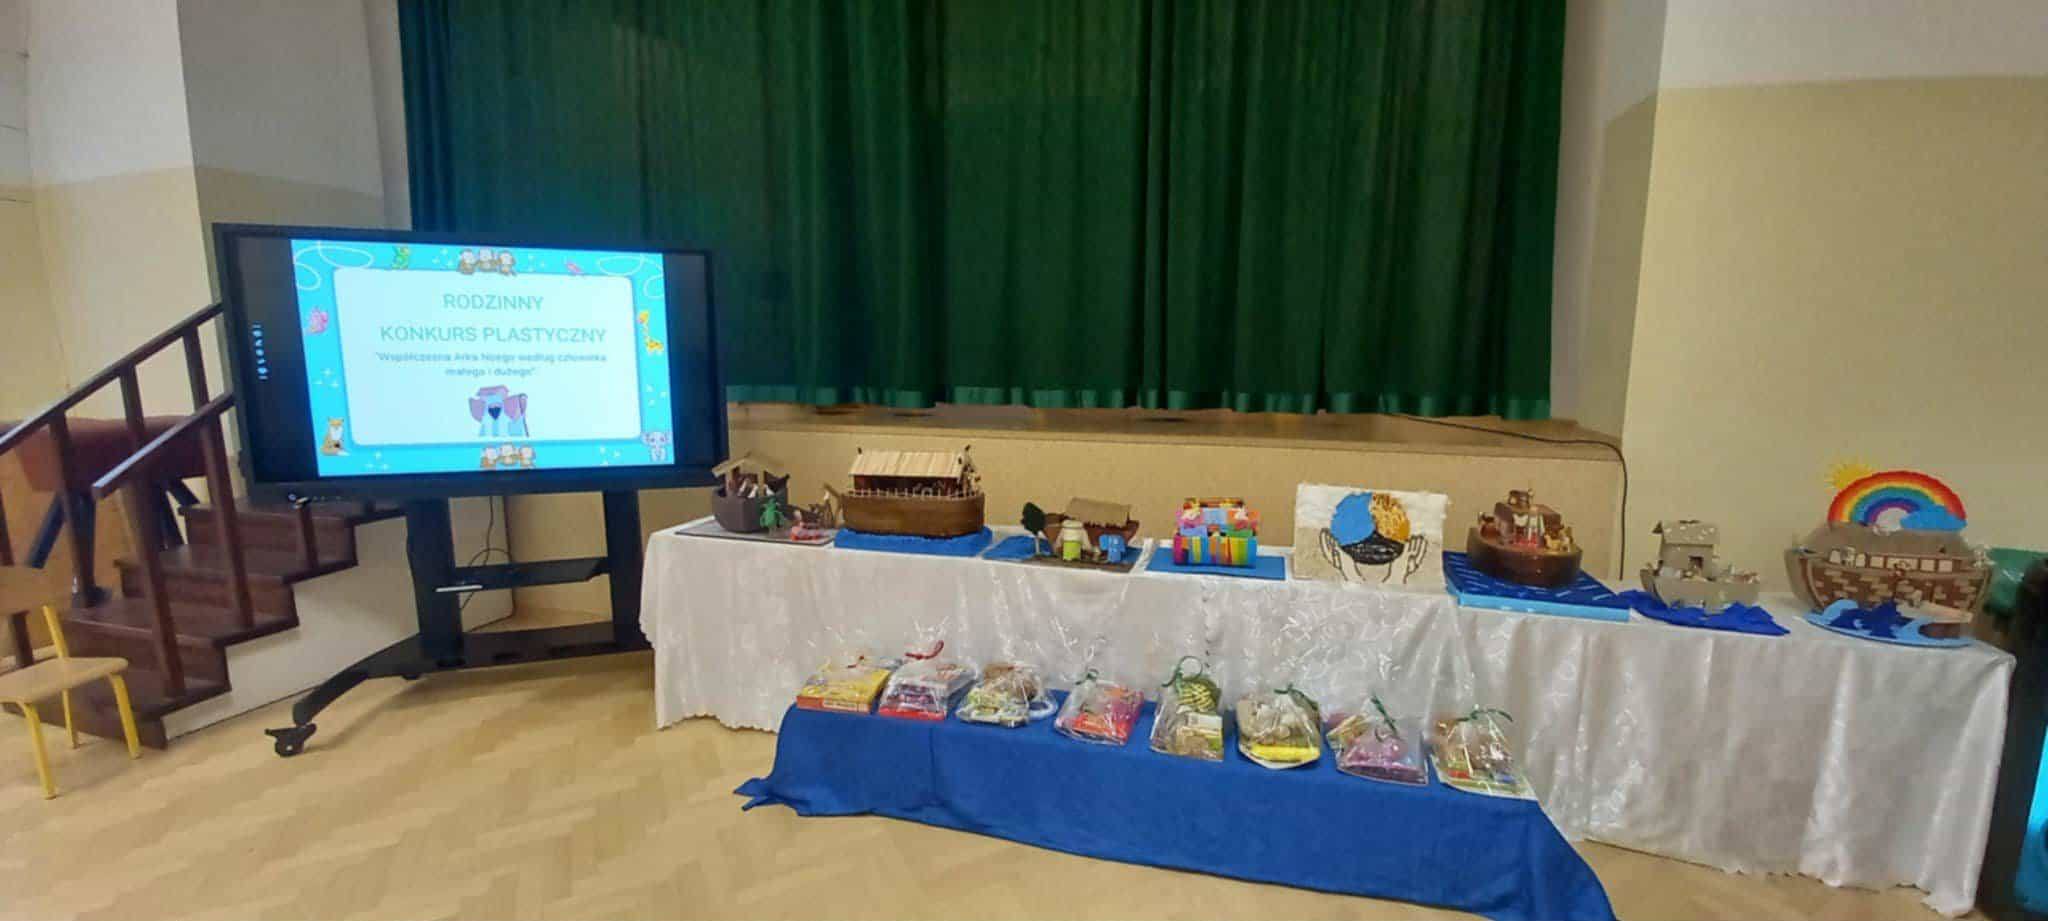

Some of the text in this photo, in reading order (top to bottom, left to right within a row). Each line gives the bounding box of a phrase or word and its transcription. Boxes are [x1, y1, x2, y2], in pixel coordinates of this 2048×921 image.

[443, 294, 544, 311] RODZINNY
[380, 326, 607, 343] KONKURS PLASTYCZNY
[454, 352, 479, 361] Arka
